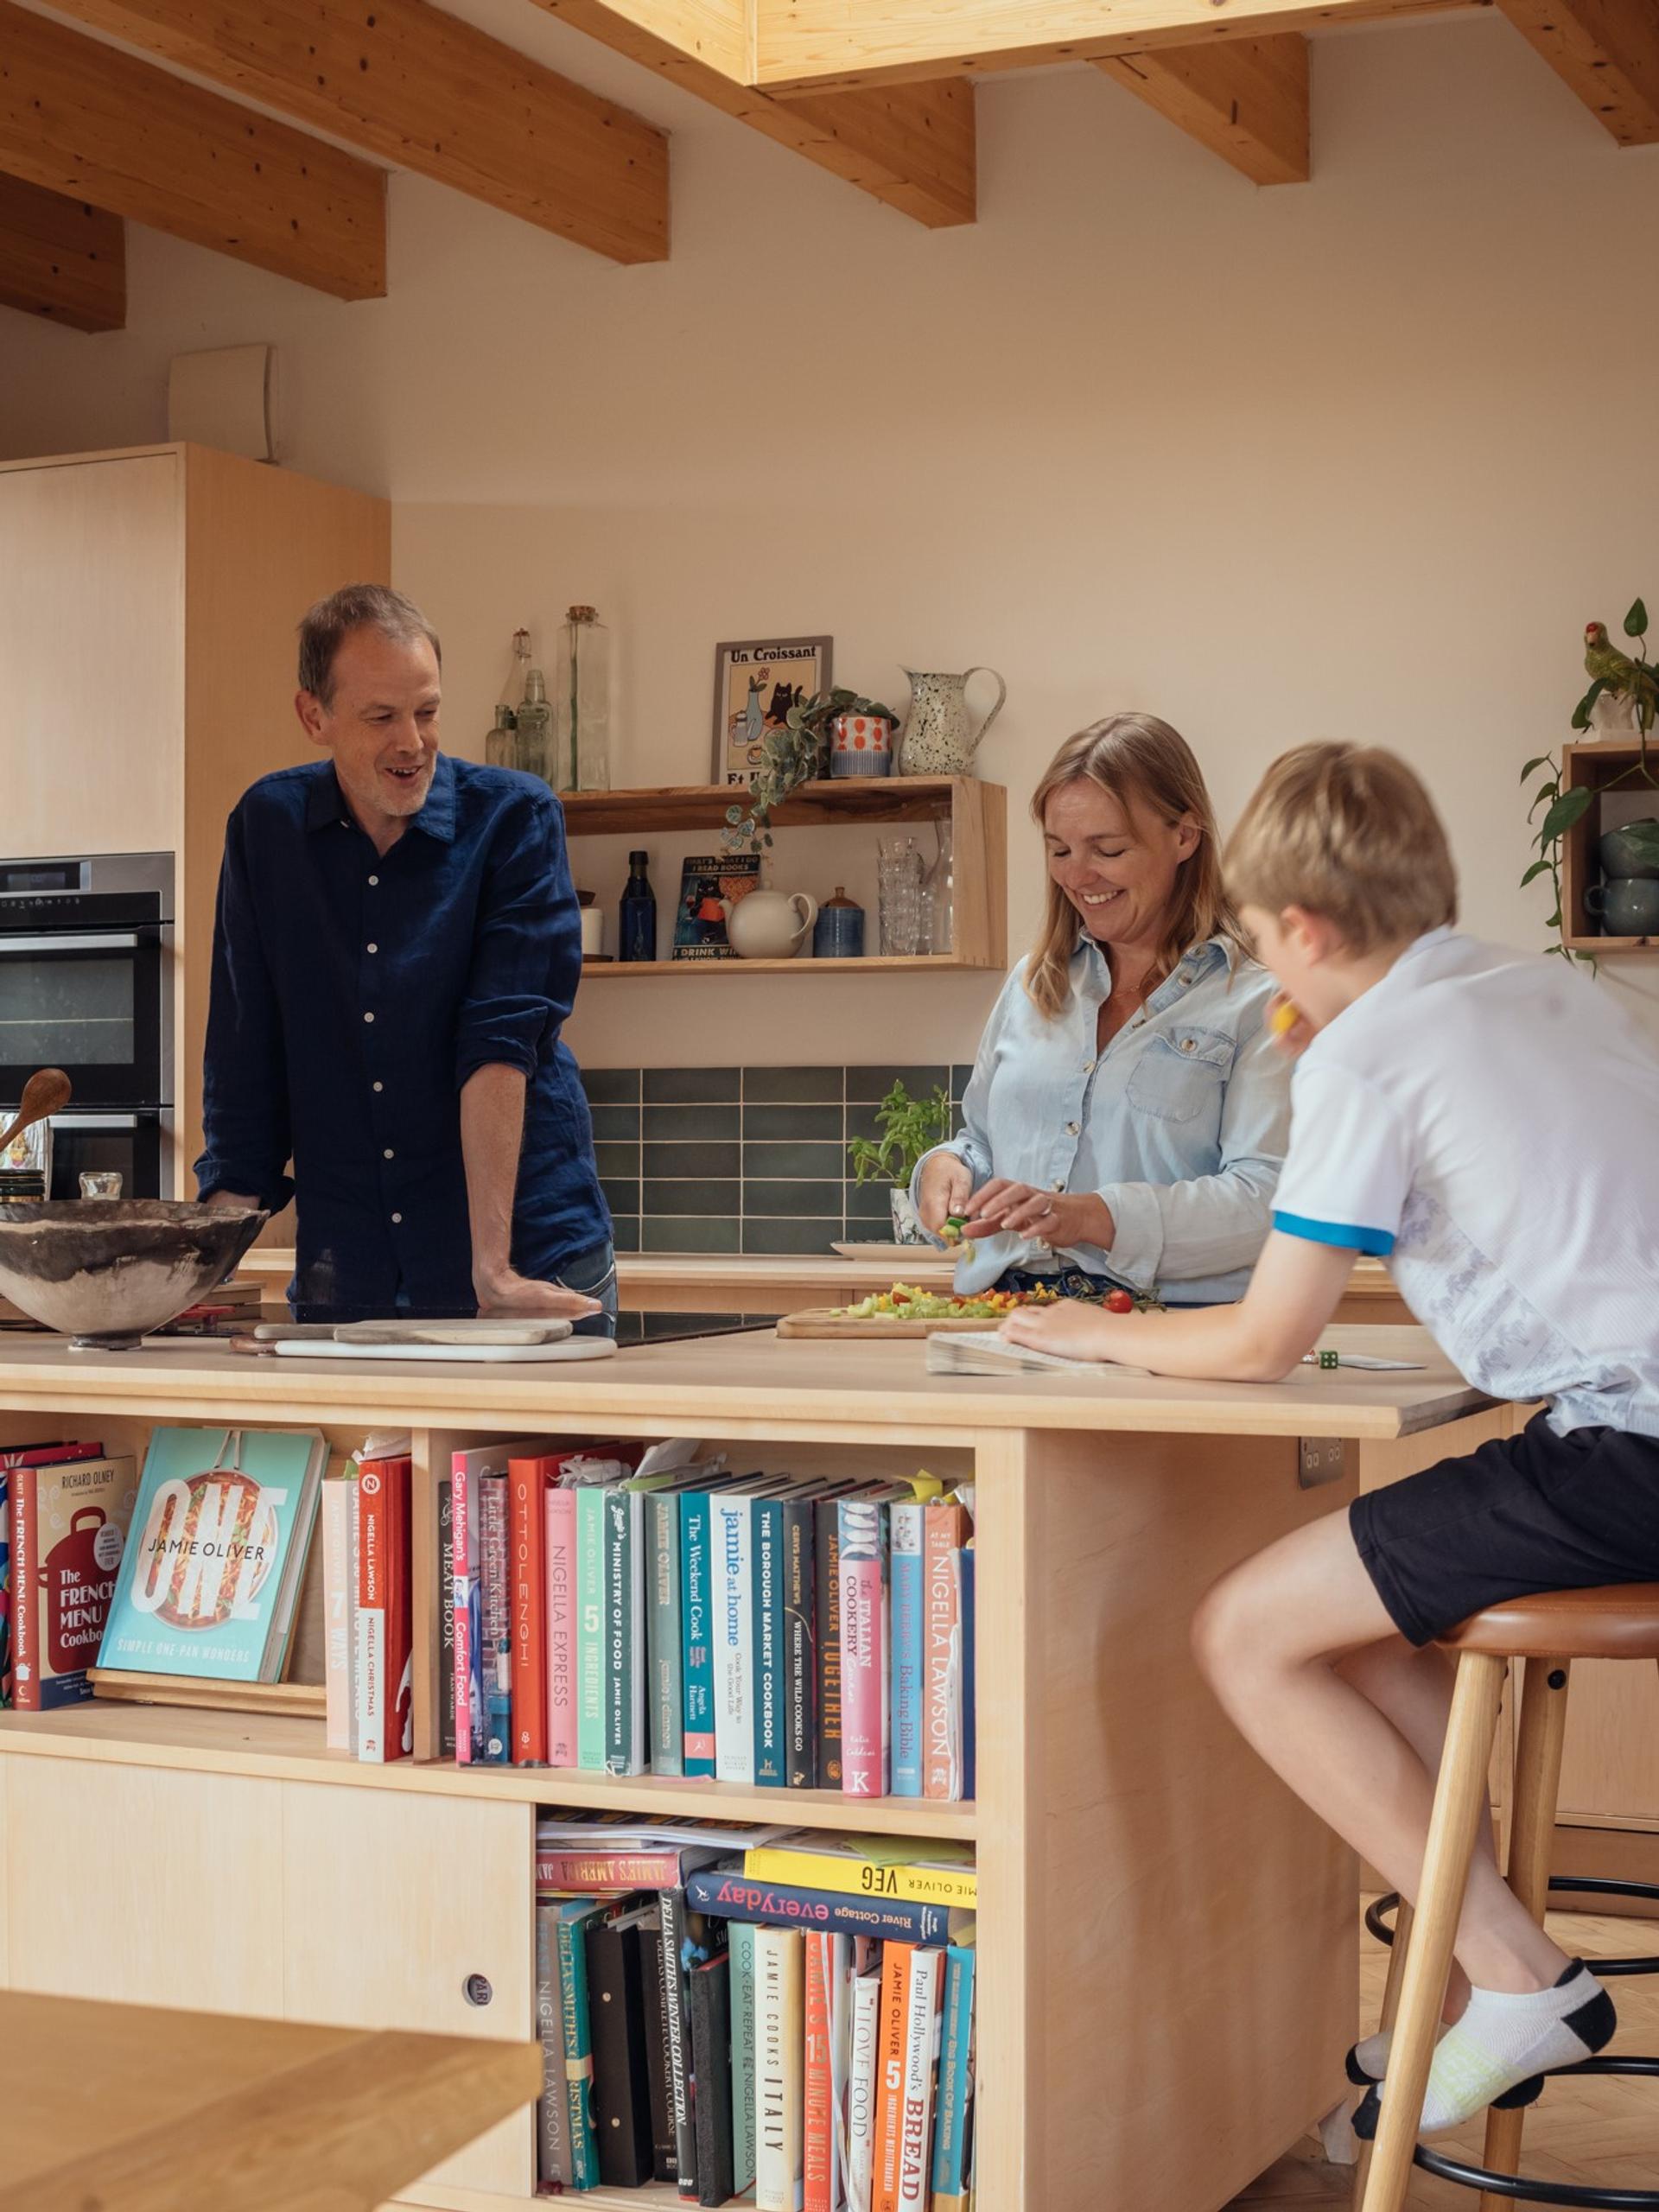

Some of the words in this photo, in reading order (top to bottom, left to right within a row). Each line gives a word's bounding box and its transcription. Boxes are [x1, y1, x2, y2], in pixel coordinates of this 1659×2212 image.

[731, 650, 748, 663] Un
[753, 646, 816, 661] Croissant
[681, 948, 715, 957] DRINK
[61, 1471, 91, 1488] RICHARD
[93, 1469, 115, 1485] OLNEY
[454, 1471, 465, 1501] Gary
[454, 1503, 465, 1560] Mehigan's
[487, 1494, 502, 1531] Little
[587, 1508, 595, 1541] JAMIE
[657, 1503, 670, 1549] JAMIE
[689, 1515, 701, 1541] The
[761, 1511, 771, 1537] THE
[16, 1519, 26, 1567] FRENCH
[130, 1478, 288, 1621] ONE
[149, 1539, 199, 1554] JAMIE
[202, 1542, 264, 1560] OLIVER
[488, 1537, 502, 1578] Green
[720, 1508, 744, 1575] jamie
[829, 1534, 838, 1576] JAMIE
[17, 1569, 26, 1602] MENU
[60, 1569, 80, 1585] The
[443, 1543, 454, 1594] MEAT
[518, 1484, 529, 1666] OTTOLENGHI
[552, 1546, 567, 1623] NIGELLA
[587, 1549, 596, 1594] OLIVER
[613, 1542, 622, 1605] MINISTRY
[658, 1552, 670, 1605] OLIVER
[690, 1546, 702, 1602] Weekend
[727, 1577, 738, 1591] at
[761, 1542, 772, 1608] BOROUGH
[792, 1556, 801, 1605] MATTHEWS
[900, 1562, 911, 1598] MARY
[60, 1605, 102, 1630] MENU
[330, 1591, 345, 1618] 7
[490, 1583, 502, 1635] Kitchen
[584, 1605, 599, 1632] 5
[613, 1609, 622, 1627] OF
[690, 1605, 702, 1639] Cook
[727, 1594, 741, 1646] home
[829, 1580, 839, 1631] OLIVER
[847, 1575, 858, 1656] COOKERY
[931, 1556, 950, 1648] NIGELLA
[17, 1605, 26, 1656] Cookbook
[60, 1630, 103, 1648] Cookbo
[443, 1599, 454, 1648] BOOK
[762, 1612, 772, 1669] MARKET
[793, 1621, 802, 1656] WHERE
[861, 1600, 872, 1668] ITALIAN
[118, 1638, 152, 1653] SIMPLE
[202, 1644, 250, 1662] WONDERS
[331, 1627, 346, 1670] WAYS
[456, 1622, 467, 1672] Comfort
[613, 1630, 622, 1670] FOOD
[793, 1657, 802, 1677] THE
[553, 1631, 568, 1707] EXPRESS
[585, 1643, 599, 1719] INGREDIENTS
[734, 1675, 743, 1694] Your
[456, 1675, 467, 1707] Food
[734, 1696, 743, 1714] Way
[763, 1673, 772, 1748] COOKBOOK
[794, 1678, 803, 1703] WILD
[899, 1665, 913, 1719] Baking
[931, 1657, 949, 1757] LAWSON
[794, 1705, 803, 1736] COOKS
[899, 1722, 913, 1759] Bible
[795, 1738, 803, 1751] GO
[851, 1771, 869, 1792] K
[536, 1863, 554, 1880] JAM
[561, 1860, 616, 1882] AMERICA
[619, 1859, 666, 1881] JAMIE'S
[861, 1866, 898, 1894] VEG
[908, 1879, 953, 1893] OLIVER
[957, 1885, 977, 1897] MIE
[662, 1897, 674, 1938] DELIA
[716, 1880, 830, 1921] everyday
[835, 1907, 880, 1924] Cottage
[882, 1915, 912, 1929] River
[664, 1938, 677, 1989] SMITH'S
[767, 1950, 779, 2000] JAMIE
[892, 1963, 903, 2004] JAMIE
[914, 1970, 927, 2000] Paul
[539, 1981, 554, 2057] NIGELLA
[564, 1983, 578, 2047] SMITH'S
[668, 1991, 681, 2044] WINTER
[890, 2009, 901, 2056] OLIVER
[767, 2013, 779, 2066] COOKS
[808, 2033, 827, 2063] 15
[910, 2005, 926, 2091] Hollywood's
[671, 2044, 687, 2126] COLLECTION
[886, 2060, 901, 2090] 5
[544, 2069, 560, 2151] LAWSON
[567, 2050, 584, 2149] CRISTMAS
[744, 2073, 754, 2121] NIGELLA
[765, 2078, 783, 2151] ITALY
[808, 2069, 827, 2126] MINUTE
[745, 2126, 755, 2179] LAWSON
[807, 2133, 827, 2183] MEALS
[902, 2097, 925, 2201] BREAD
